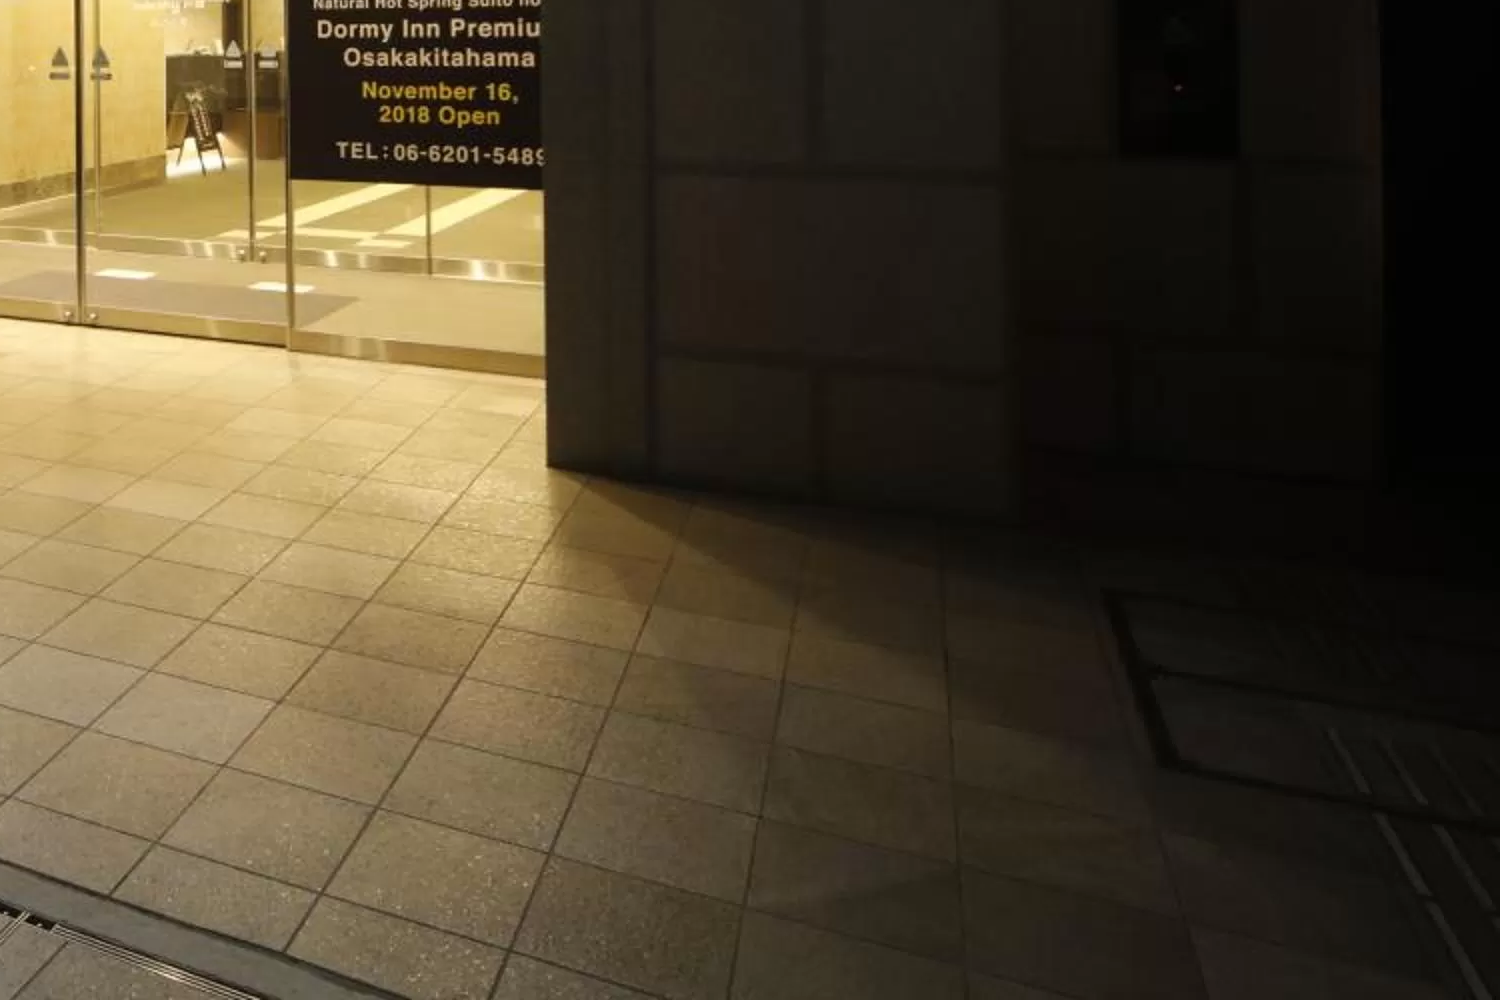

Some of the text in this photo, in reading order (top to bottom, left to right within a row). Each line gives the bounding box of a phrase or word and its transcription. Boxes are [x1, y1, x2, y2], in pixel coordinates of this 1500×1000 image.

[317, 19, 393, 43] Dormy
[403, 19, 440, 38] Inn
[343, 47, 536, 67] Osakakitahama
[361, 81, 519, 104] November 16,
[379, 106, 500, 128] 2018 Open
